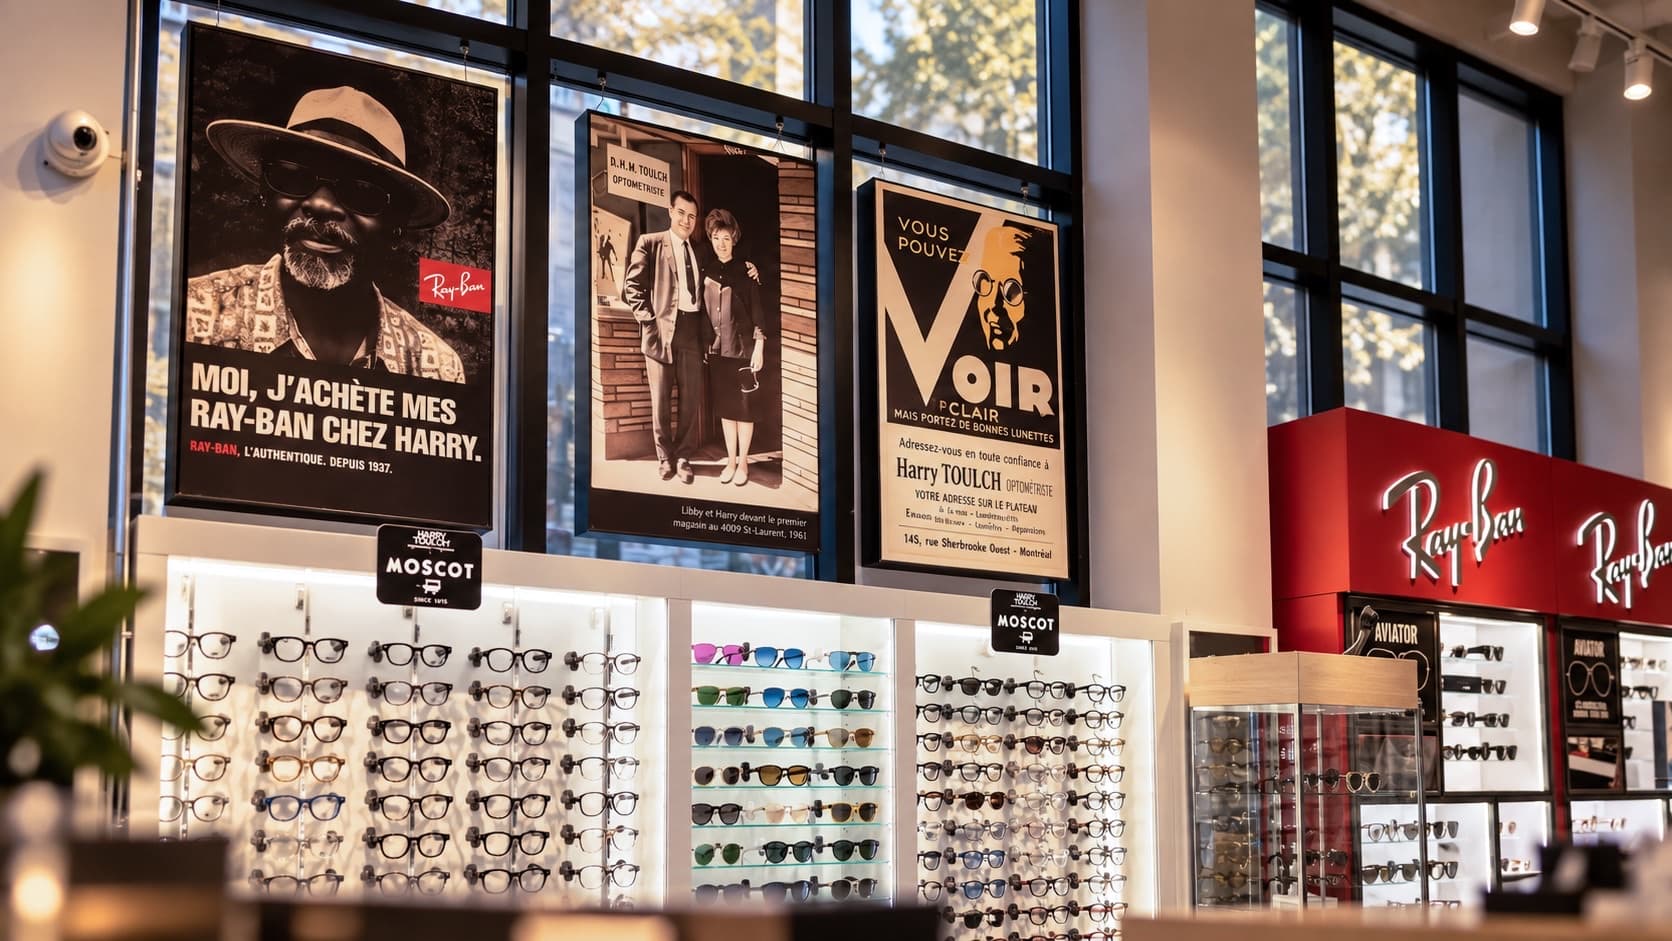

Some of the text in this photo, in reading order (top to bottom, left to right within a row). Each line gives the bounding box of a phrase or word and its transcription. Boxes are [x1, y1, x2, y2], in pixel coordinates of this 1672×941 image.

[612, 174, 665, 197] OPTOMETRISTE
[639, 164, 668, 183] TOULCH
[897, 216, 950, 241] VOUS
[898, 236, 970, 264] POUVEZ
[423, 271, 486, 302] Ray-Ban
[882, 212, 1055, 418] VOIR
[191, 362, 457, 425] MOI, J'ACHÈTE MES
[190, 398, 482, 462] RAY-BAN CHEZ HARRY.
[894, 408, 1054, 443] MAIS PORTEZ DE BONNES LUNETTES
[190, 440, 393, 474] RAY-BAN, L'AUTHENTIQUE. DEPUIS 1937.
[898, 437, 1049, 470] Adressez-vous en toute confiance à
[896, 457, 938, 487] Harry
[941, 463, 1002, 491] TOULCH
[915, 489, 940, 502] VOTRE
[942, 492, 976, 507] ADRESSE
[978, 496, 993, 509] SUR
[995, 499, 1004, 510] LE
[681, 505, 807, 528] Libby et Harry devant le premier
[1381, 457, 1525, 587] Ray-Ban
[417, 530, 447, 541] HARRY
[673, 519, 807, 540] magasin au 4009 St-Laurent, 1961
[412, 536, 451, 548] TOULCH
[925, 538, 939, 547] rue
[941, 537, 987, 553] Sherbrooke
[989, 543, 1010, 555] Ouest
[385, 556, 475, 580] MOSCOT
[997, 614, 1055, 631] MOSCOT
[1374, 622, 1418, 645] AVIATOR
[1573, 638, 1606, 658] AVIATOR
